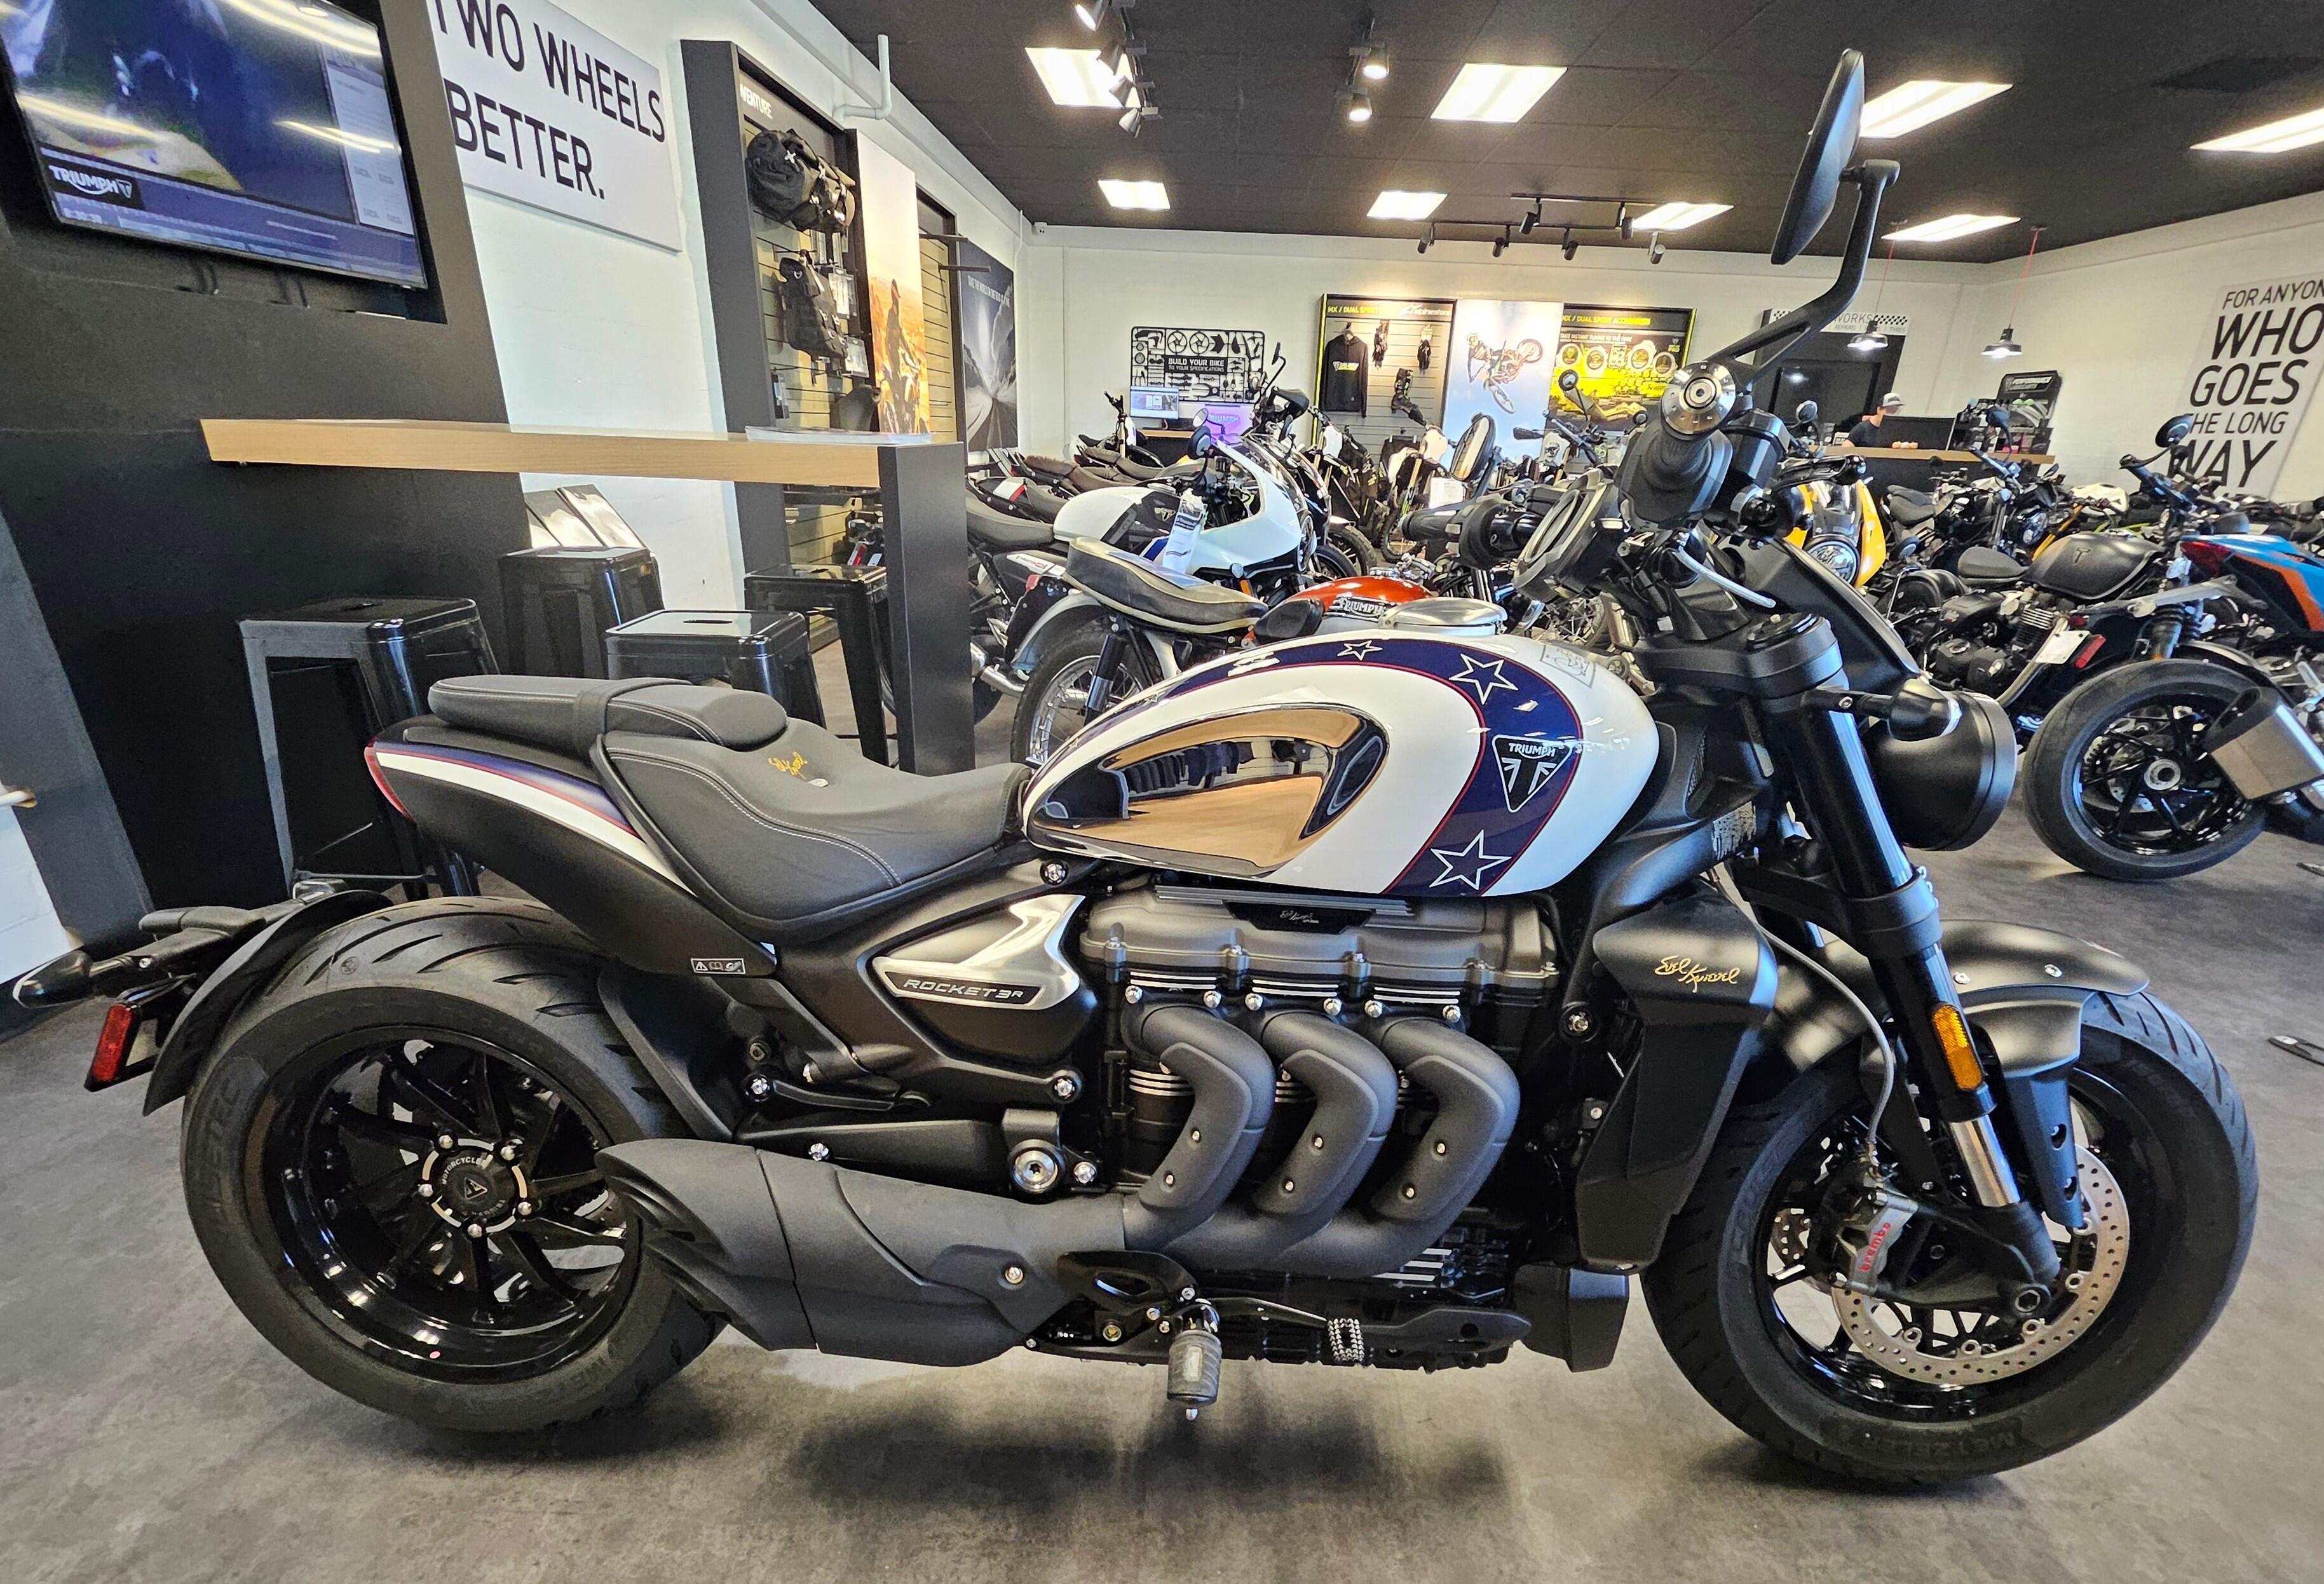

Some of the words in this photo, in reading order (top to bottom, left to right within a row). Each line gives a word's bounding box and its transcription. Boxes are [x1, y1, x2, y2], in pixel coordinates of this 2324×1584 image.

[533, 22, 665, 142] WHEELS
[444, 78, 604, 200] BETTER.
[48, 165, 119, 195] TRIUMPH
[2222, 288, 2259, 309] FOR
[2259, 279, 2324, 305] ANYON
[2212, 303, 2324, 360] WHO
[2190, 359, 2309, 407] GOES
[1209, 414, 1239, 423] RIUMPH
[2224, 412, 2288, 434] LONG
[2168, 440, 2278, 487] WAY
[1508, 742, 1556, 759] TRIUMPH
[1654, 955, 1691, 975] Evel
[1678, 963, 1741, 993] Knievel
[1858, 1222, 1891, 1273] brembo
